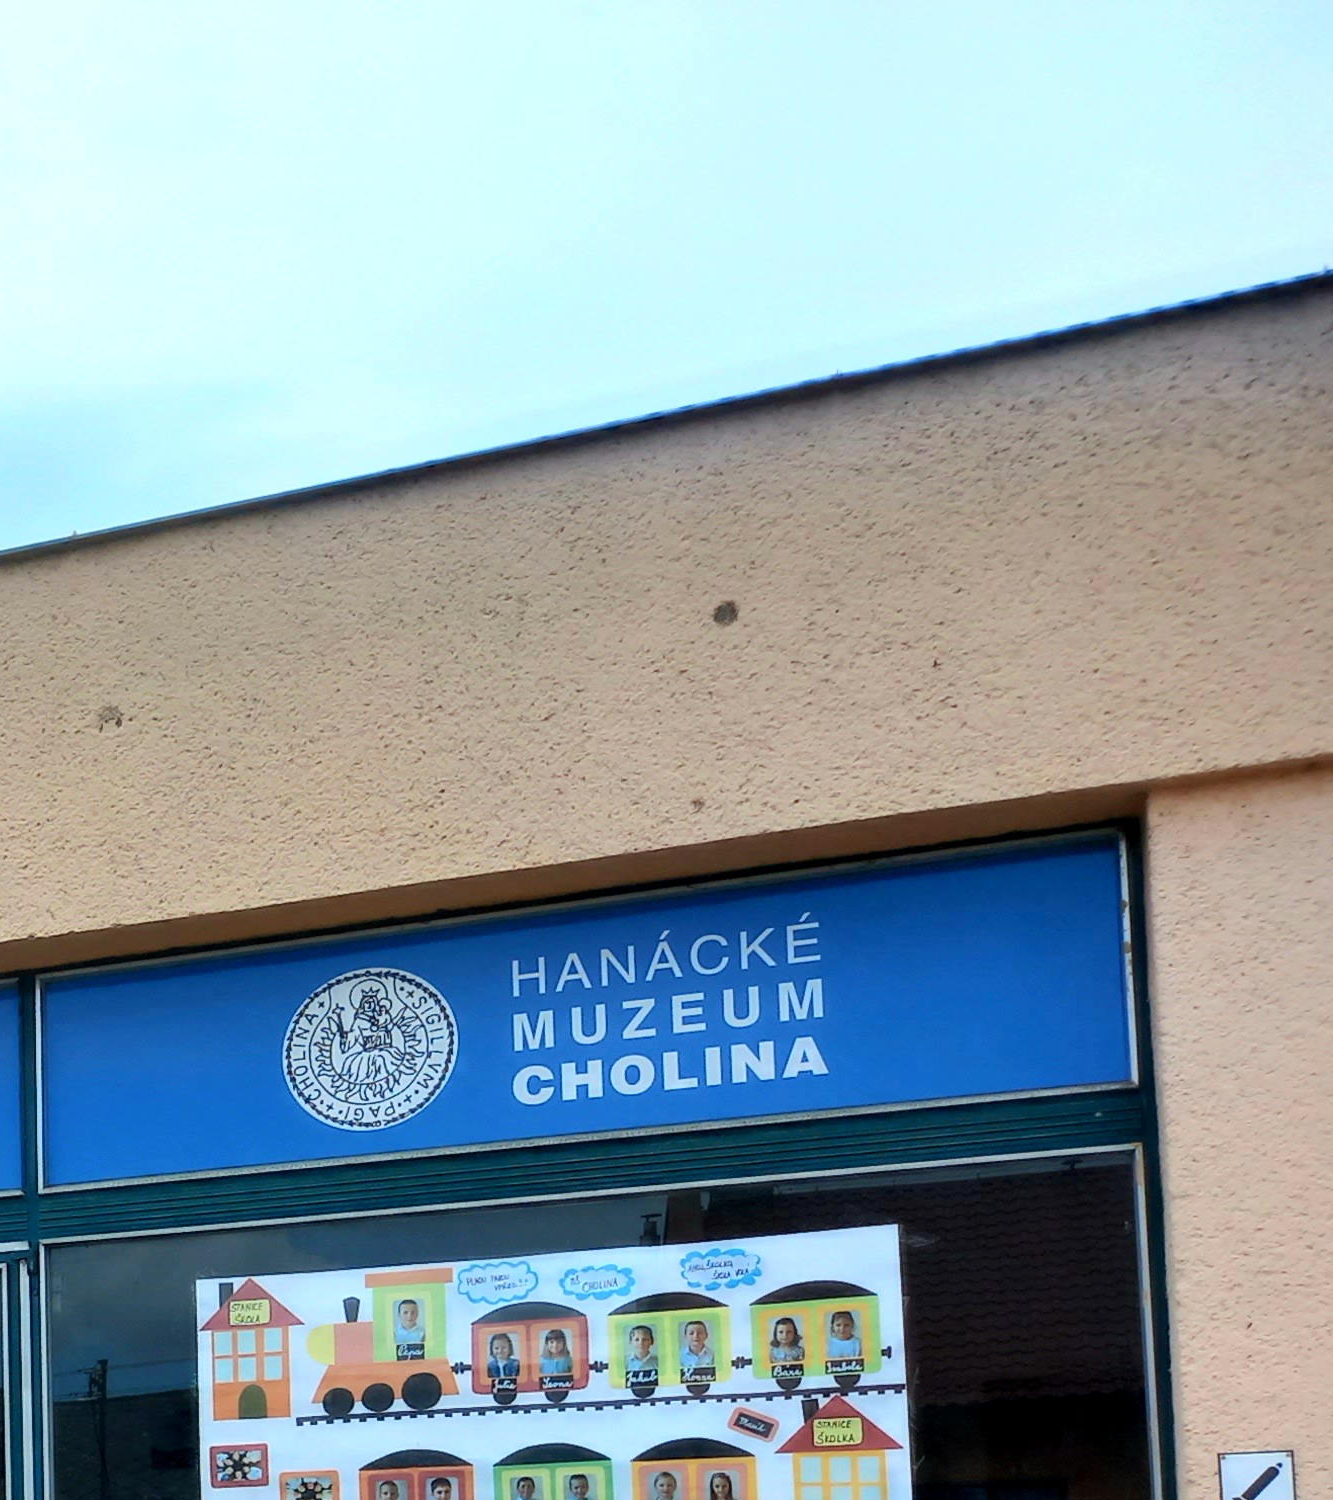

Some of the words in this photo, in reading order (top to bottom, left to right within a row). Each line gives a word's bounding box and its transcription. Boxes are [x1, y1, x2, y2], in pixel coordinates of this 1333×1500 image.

[512, 912, 821, 997] HANÁCKÉ
[513, 978, 824, 1052] MUZEUM
[512, 1036, 829, 1105] CHOLINA
[582, 1277, 618, 1292] CHOLINA
[230, 1302, 263, 1313] STANICE
[234, 1313, 261, 1324] ŠKOLA
[816, 1420, 852, 1429] STANICE
[816, 1432, 855, 1444] ŠKOLKA
